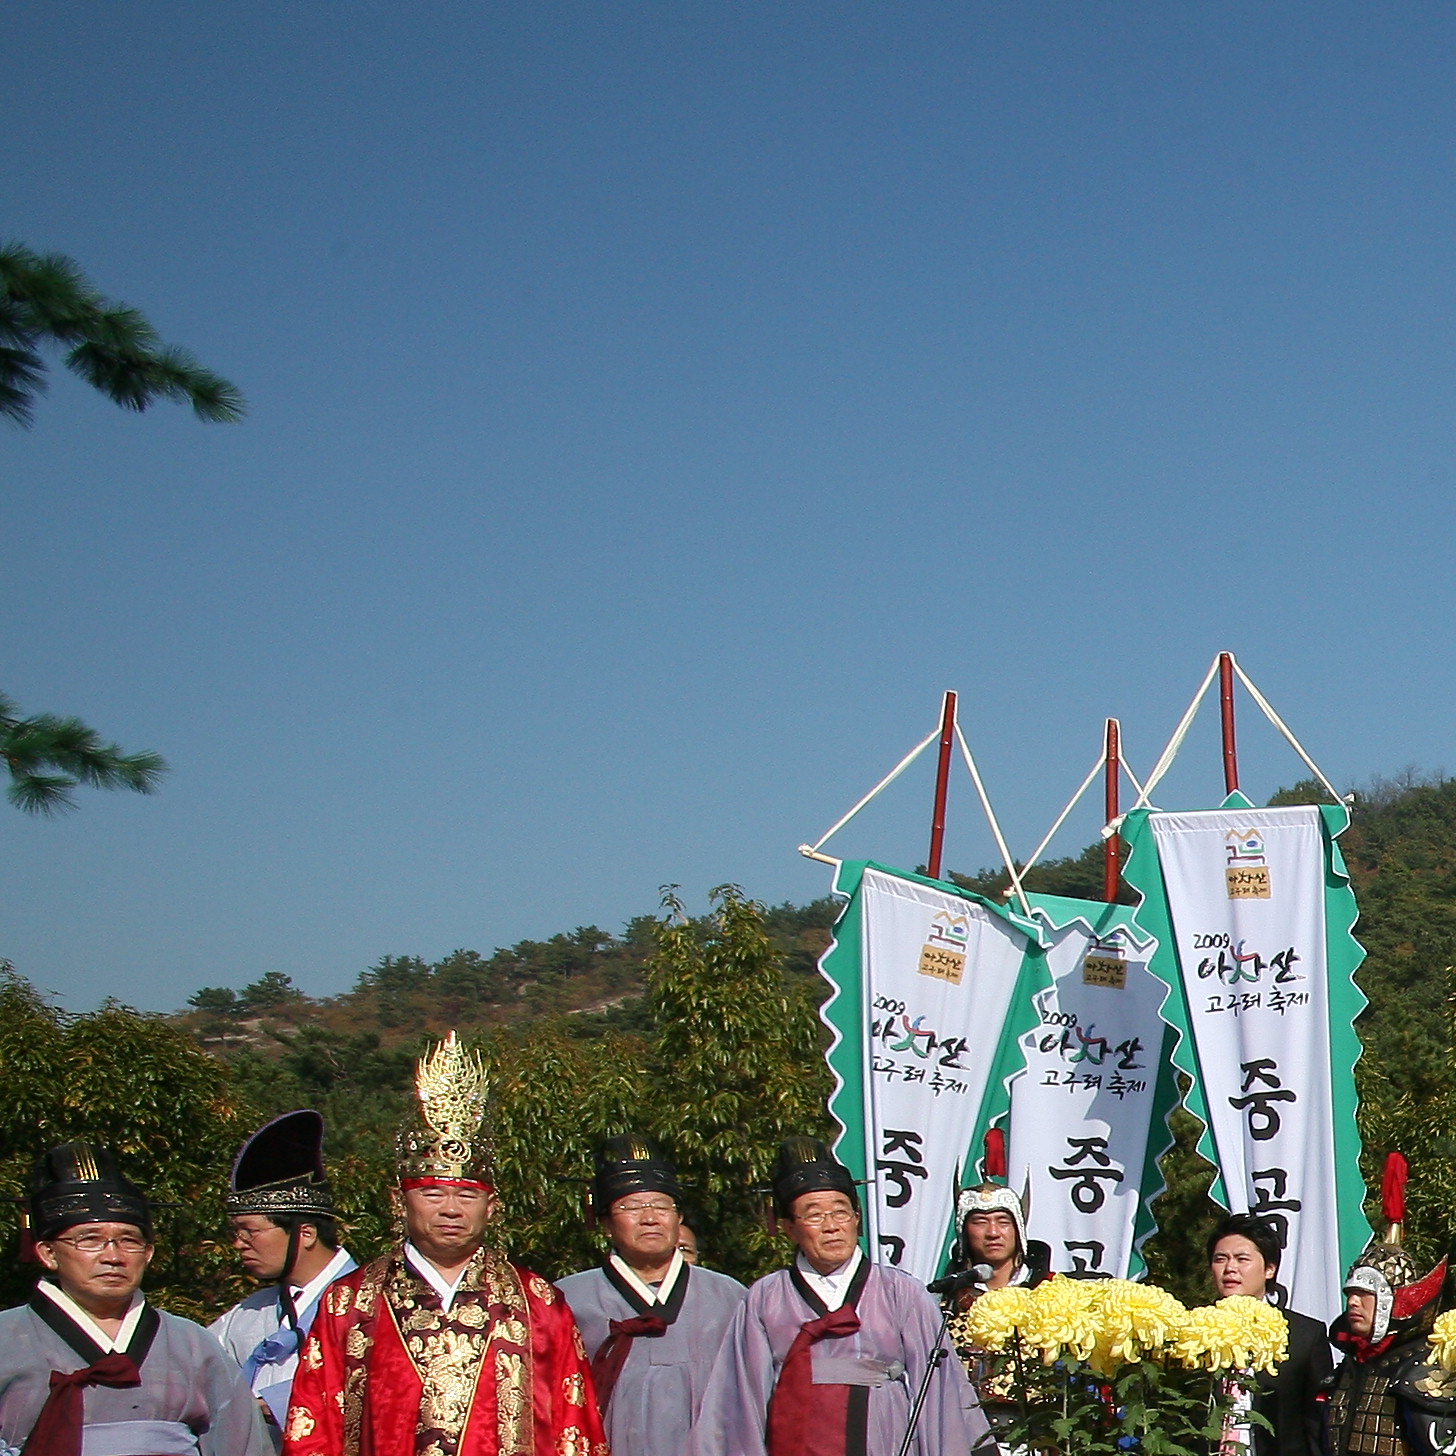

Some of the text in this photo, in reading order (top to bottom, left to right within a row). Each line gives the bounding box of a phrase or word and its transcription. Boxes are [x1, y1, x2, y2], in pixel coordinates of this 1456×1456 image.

[1228, 870, 1267, 885] 아차산
[1193, 933, 1230, 949] 2009
[1197, 939, 1306, 985] 아차산
[872, 992, 906, 1015] 2009
[1204, 985, 1310, 1017] 고구려 축제
[1042, 1010, 1078, 1028] 2009
[872, 1014, 971, 1070] 아차산
[1040, 1023, 1146, 1070] 아차산
[873, 1055, 969, 1098] 고구려 축제
[1040, 1070, 1146, 1101] 고구려 축제
